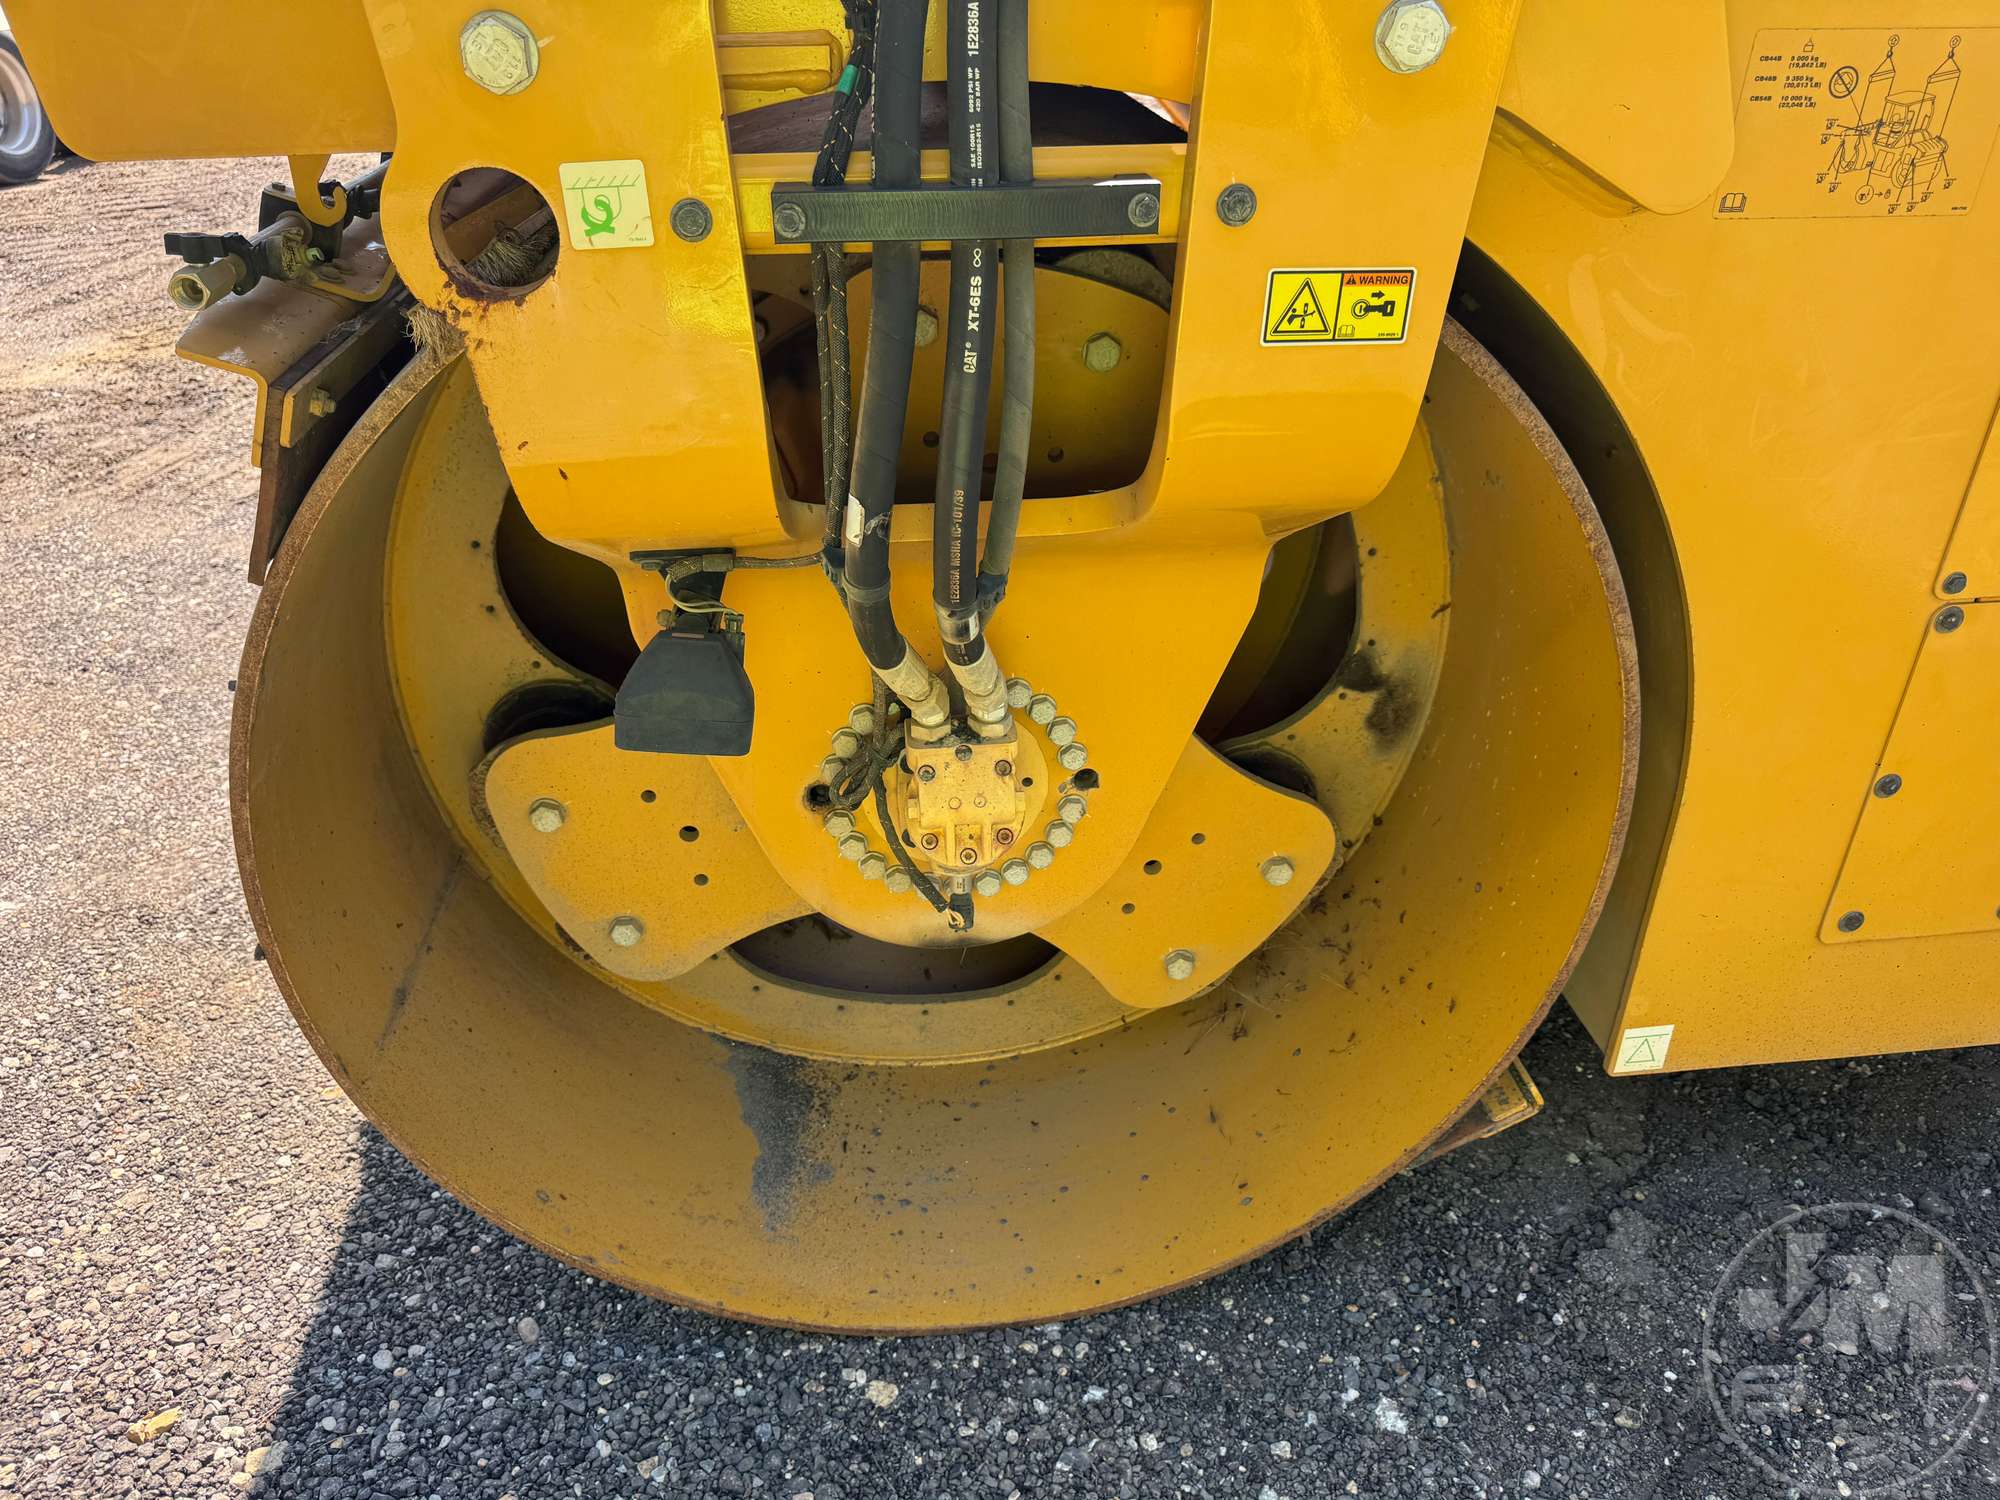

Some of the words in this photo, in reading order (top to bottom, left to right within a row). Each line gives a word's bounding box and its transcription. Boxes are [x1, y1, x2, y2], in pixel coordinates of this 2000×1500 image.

[967, 1, 979, 57] 1E2836A
[1810, 55, 1819, 63] kg
[967, 67, 974, 79] WP
[974, 67, 981, 80] WP
[1359, 275, 1409, 285] WARNING
[967, 275, 983, 332] XT-6ES
